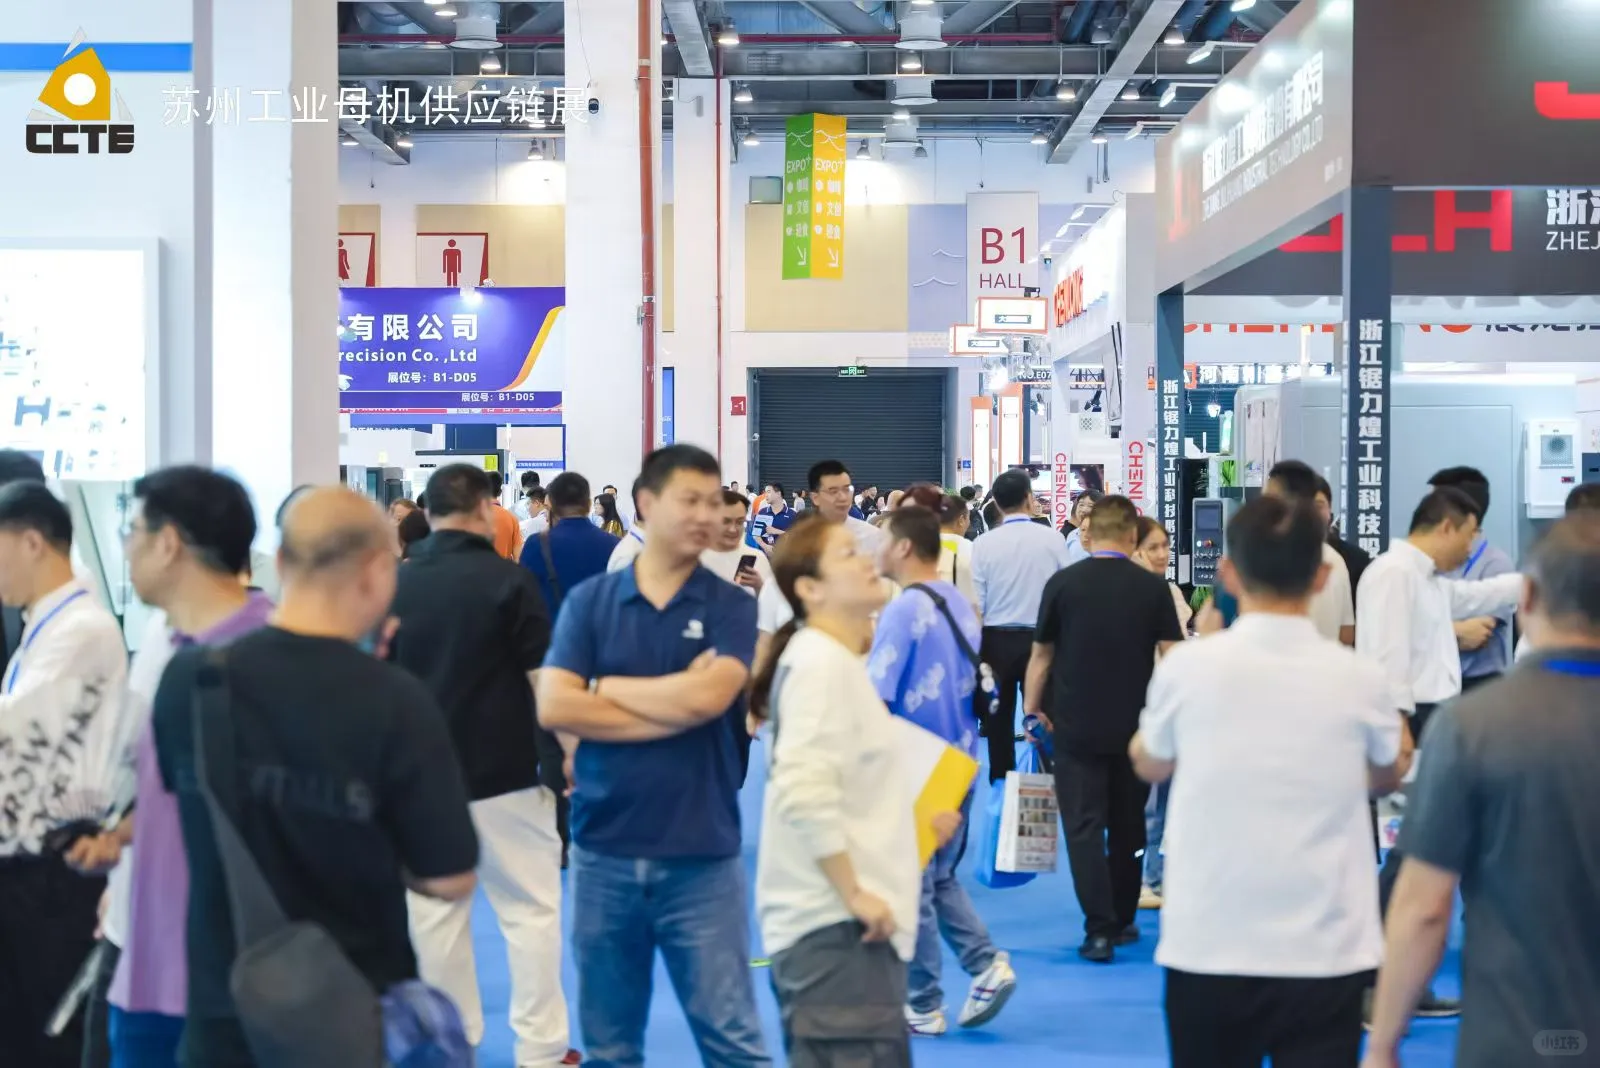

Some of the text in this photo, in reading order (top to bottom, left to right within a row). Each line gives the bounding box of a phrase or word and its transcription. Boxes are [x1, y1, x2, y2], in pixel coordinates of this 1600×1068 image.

[981, 226, 1025, 265] B1
[979, 272, 1027, 289] HALL
[347, 313, 478, 341] 有限公司
[411, 348, 439, 362] Co.
[433, 373, 477, 383] B1-D05
[498, 392, 535, 401] B1-D05
